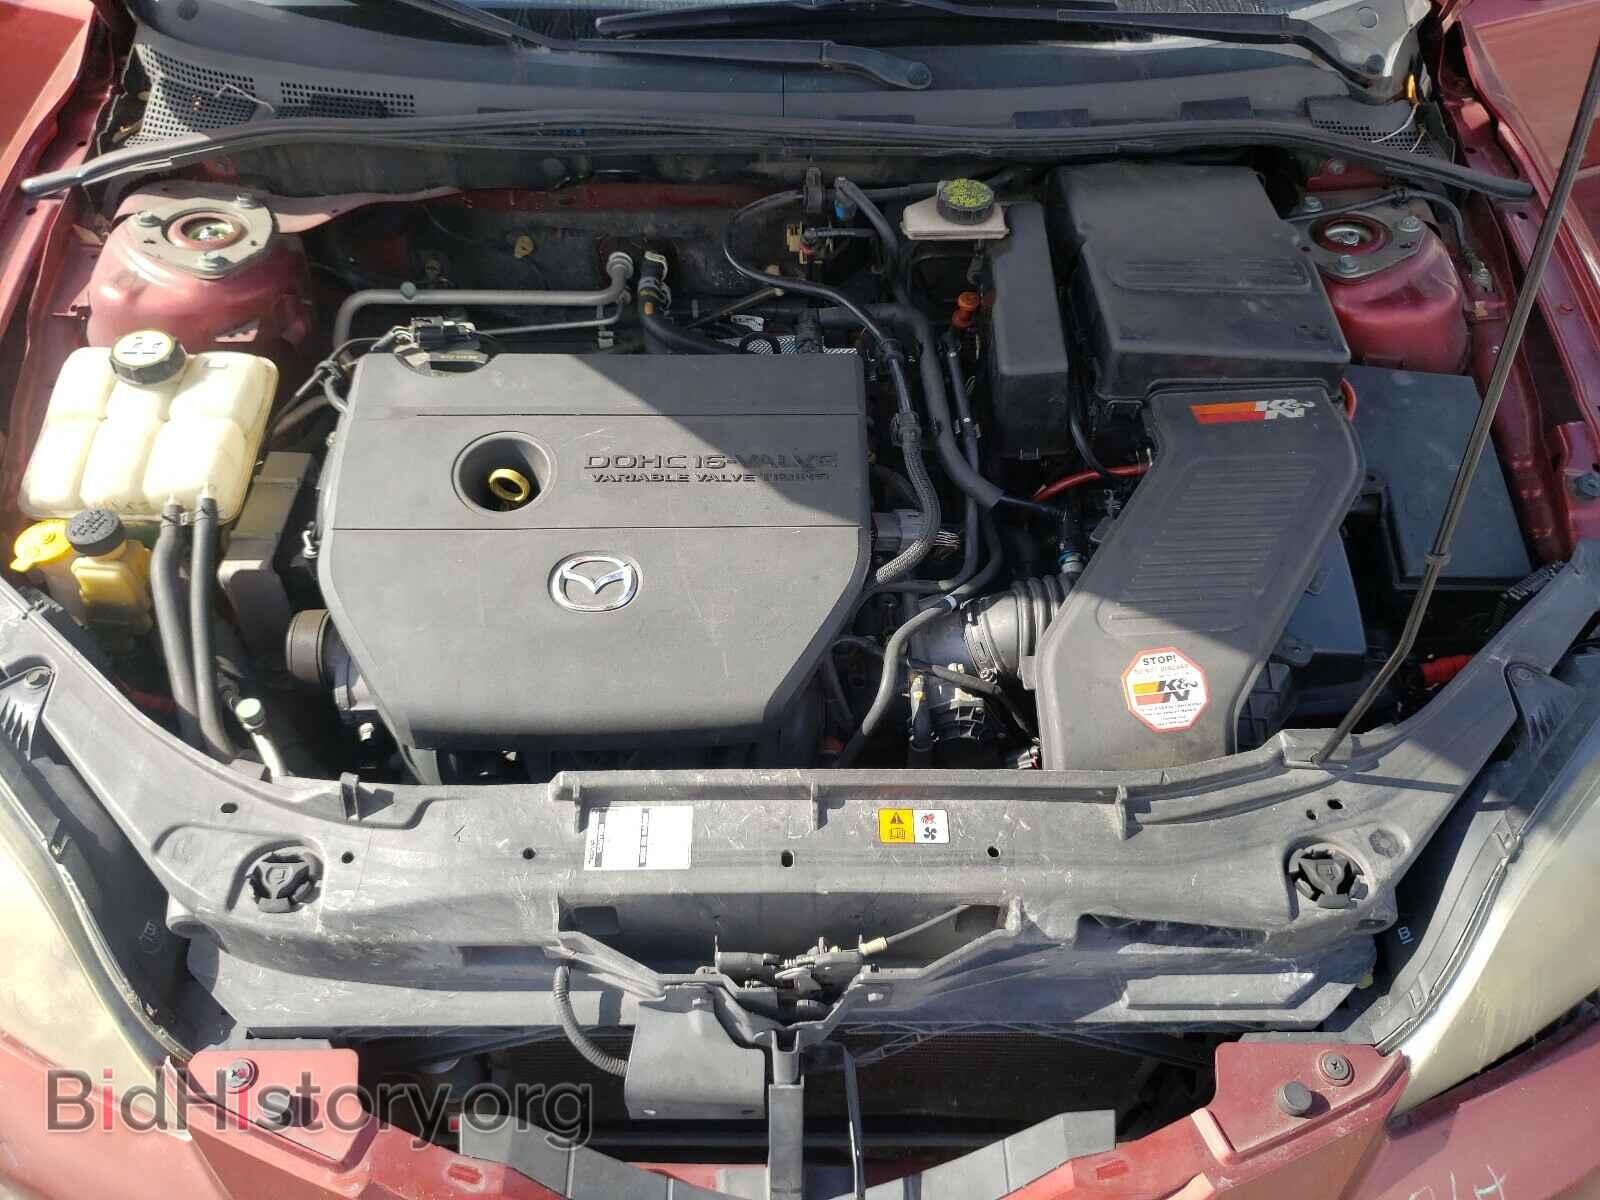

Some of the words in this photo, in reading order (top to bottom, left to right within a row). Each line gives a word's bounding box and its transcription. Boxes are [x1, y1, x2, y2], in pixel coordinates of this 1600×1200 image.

[584, 453, 686, 469] DOHC
[695, 453, 838, 469] 16-VALVE
[591, 471, 690, 482] VARIABLE
[694, 471, 756, 482] VALVE
[1143, 654, 1177, 666] STOP!
[1158, 678, 1199, 703] K&N
